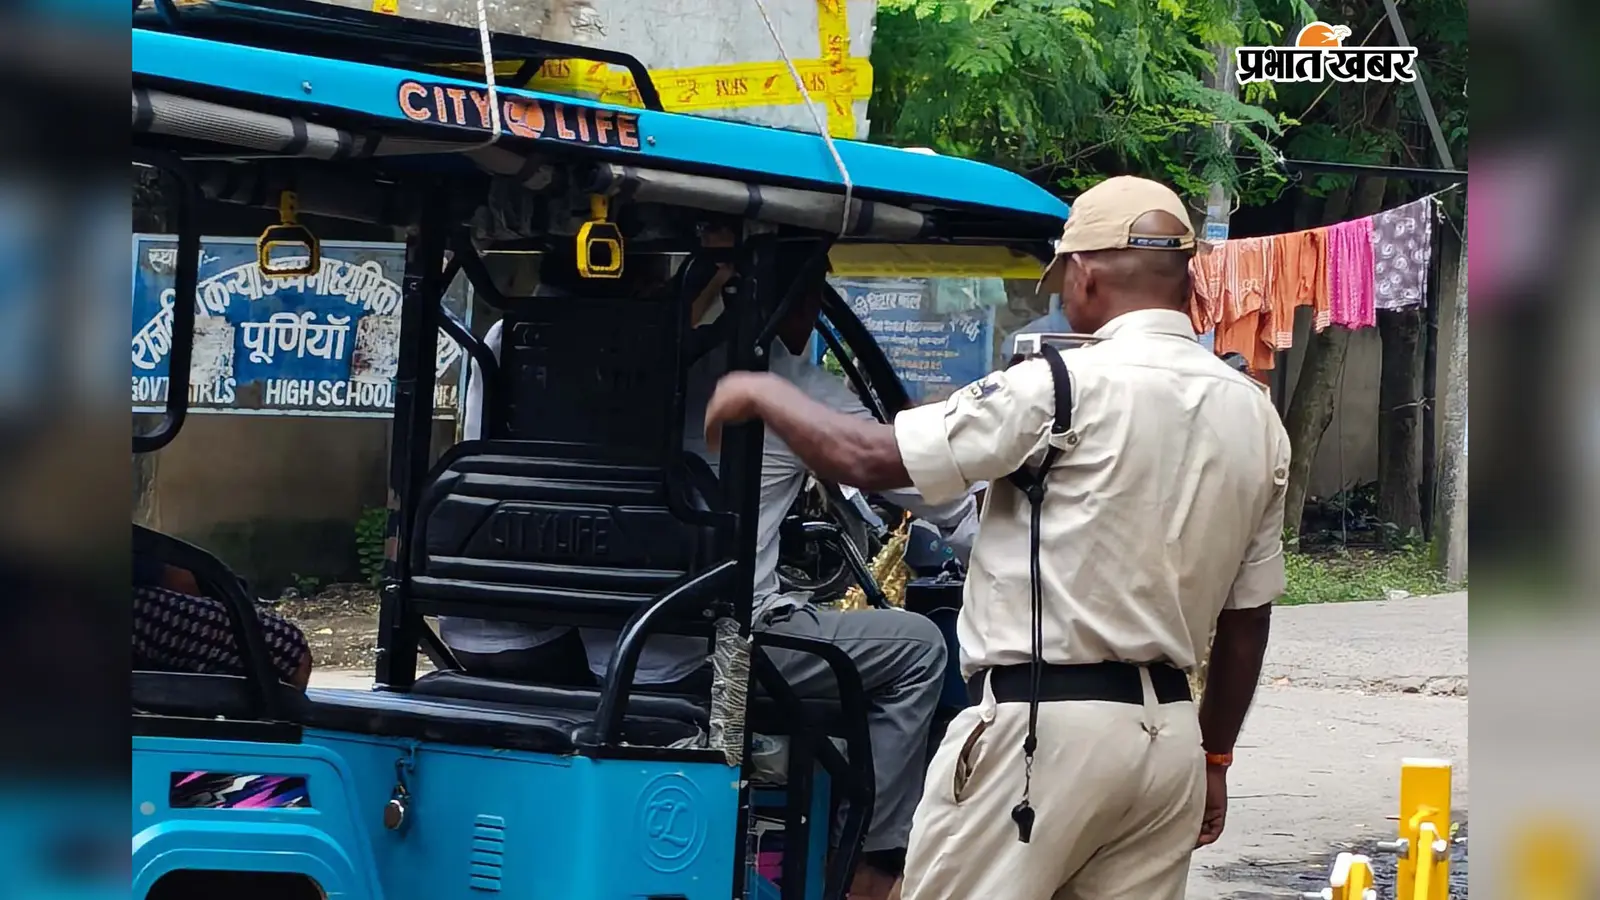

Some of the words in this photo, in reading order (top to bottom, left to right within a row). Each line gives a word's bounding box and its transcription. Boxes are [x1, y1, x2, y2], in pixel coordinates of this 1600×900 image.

[399, 81, 494, 129] CITY
[553, 102, 640, 148] LIFE
[188, 377, 237, 404] IRLS
[265, 379, 315, 406] HIGH
[316, 379, 395, 408] SCHOOL
